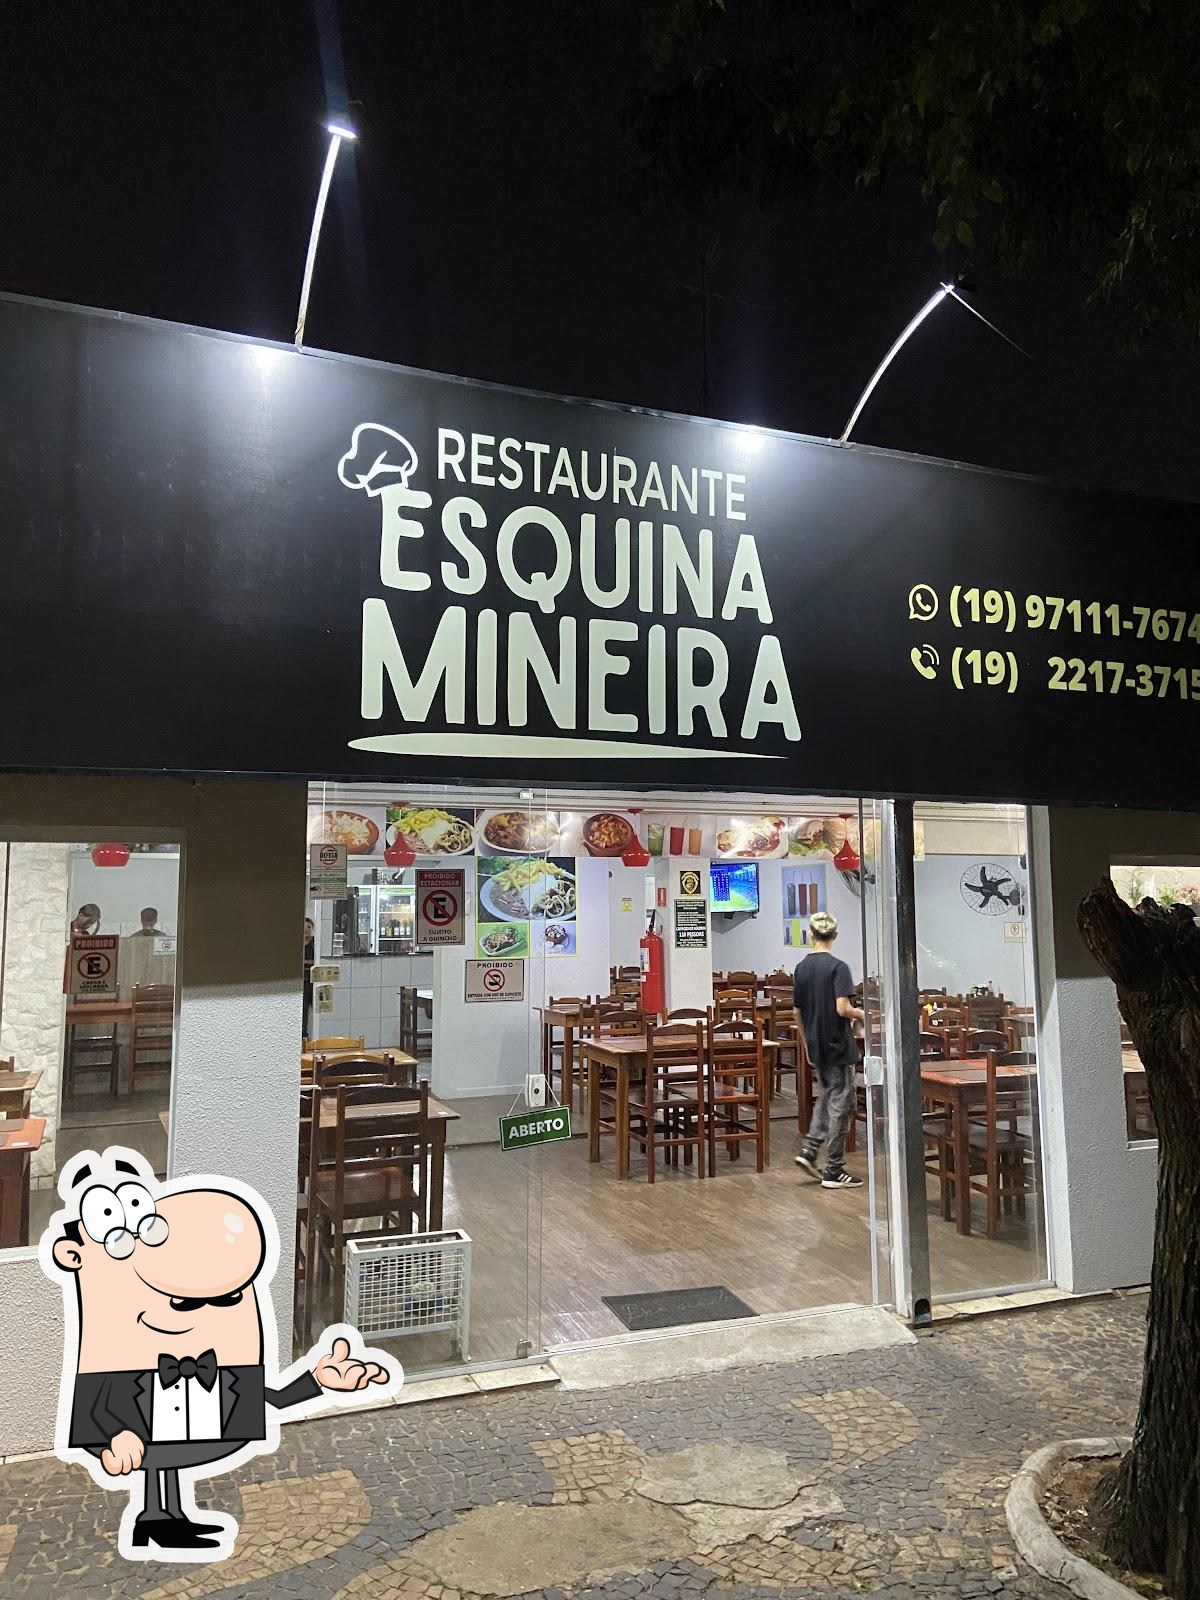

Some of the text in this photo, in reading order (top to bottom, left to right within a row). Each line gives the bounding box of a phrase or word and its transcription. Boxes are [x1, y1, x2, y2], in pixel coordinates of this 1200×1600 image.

[437, 427, 747, 521] RESTAURANTE
[379, 486, 774, 624] ESQUINA
[949, 585, 1200, 644] (19) 97111-7674
[360, 597, 802, 742] MINEIRA
[951, 646, 1019, 694] (19)
[508, 1117, 564, 1140] ABERTO
